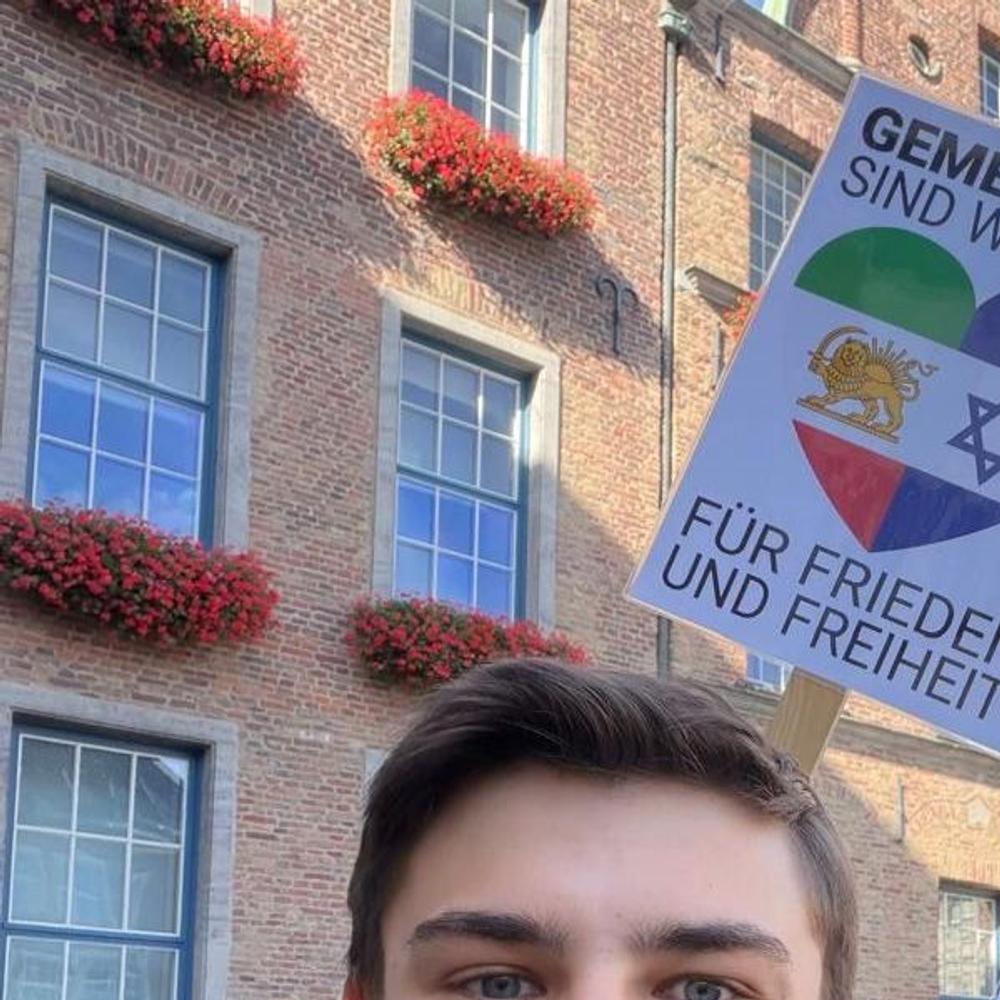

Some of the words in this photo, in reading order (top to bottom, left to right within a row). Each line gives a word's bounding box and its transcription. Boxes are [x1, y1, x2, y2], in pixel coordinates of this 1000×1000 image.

[840, 155, 955, 227] SIND
[680, 495, 790, 575] FÜR
[662, 543, 770, 619] UND
